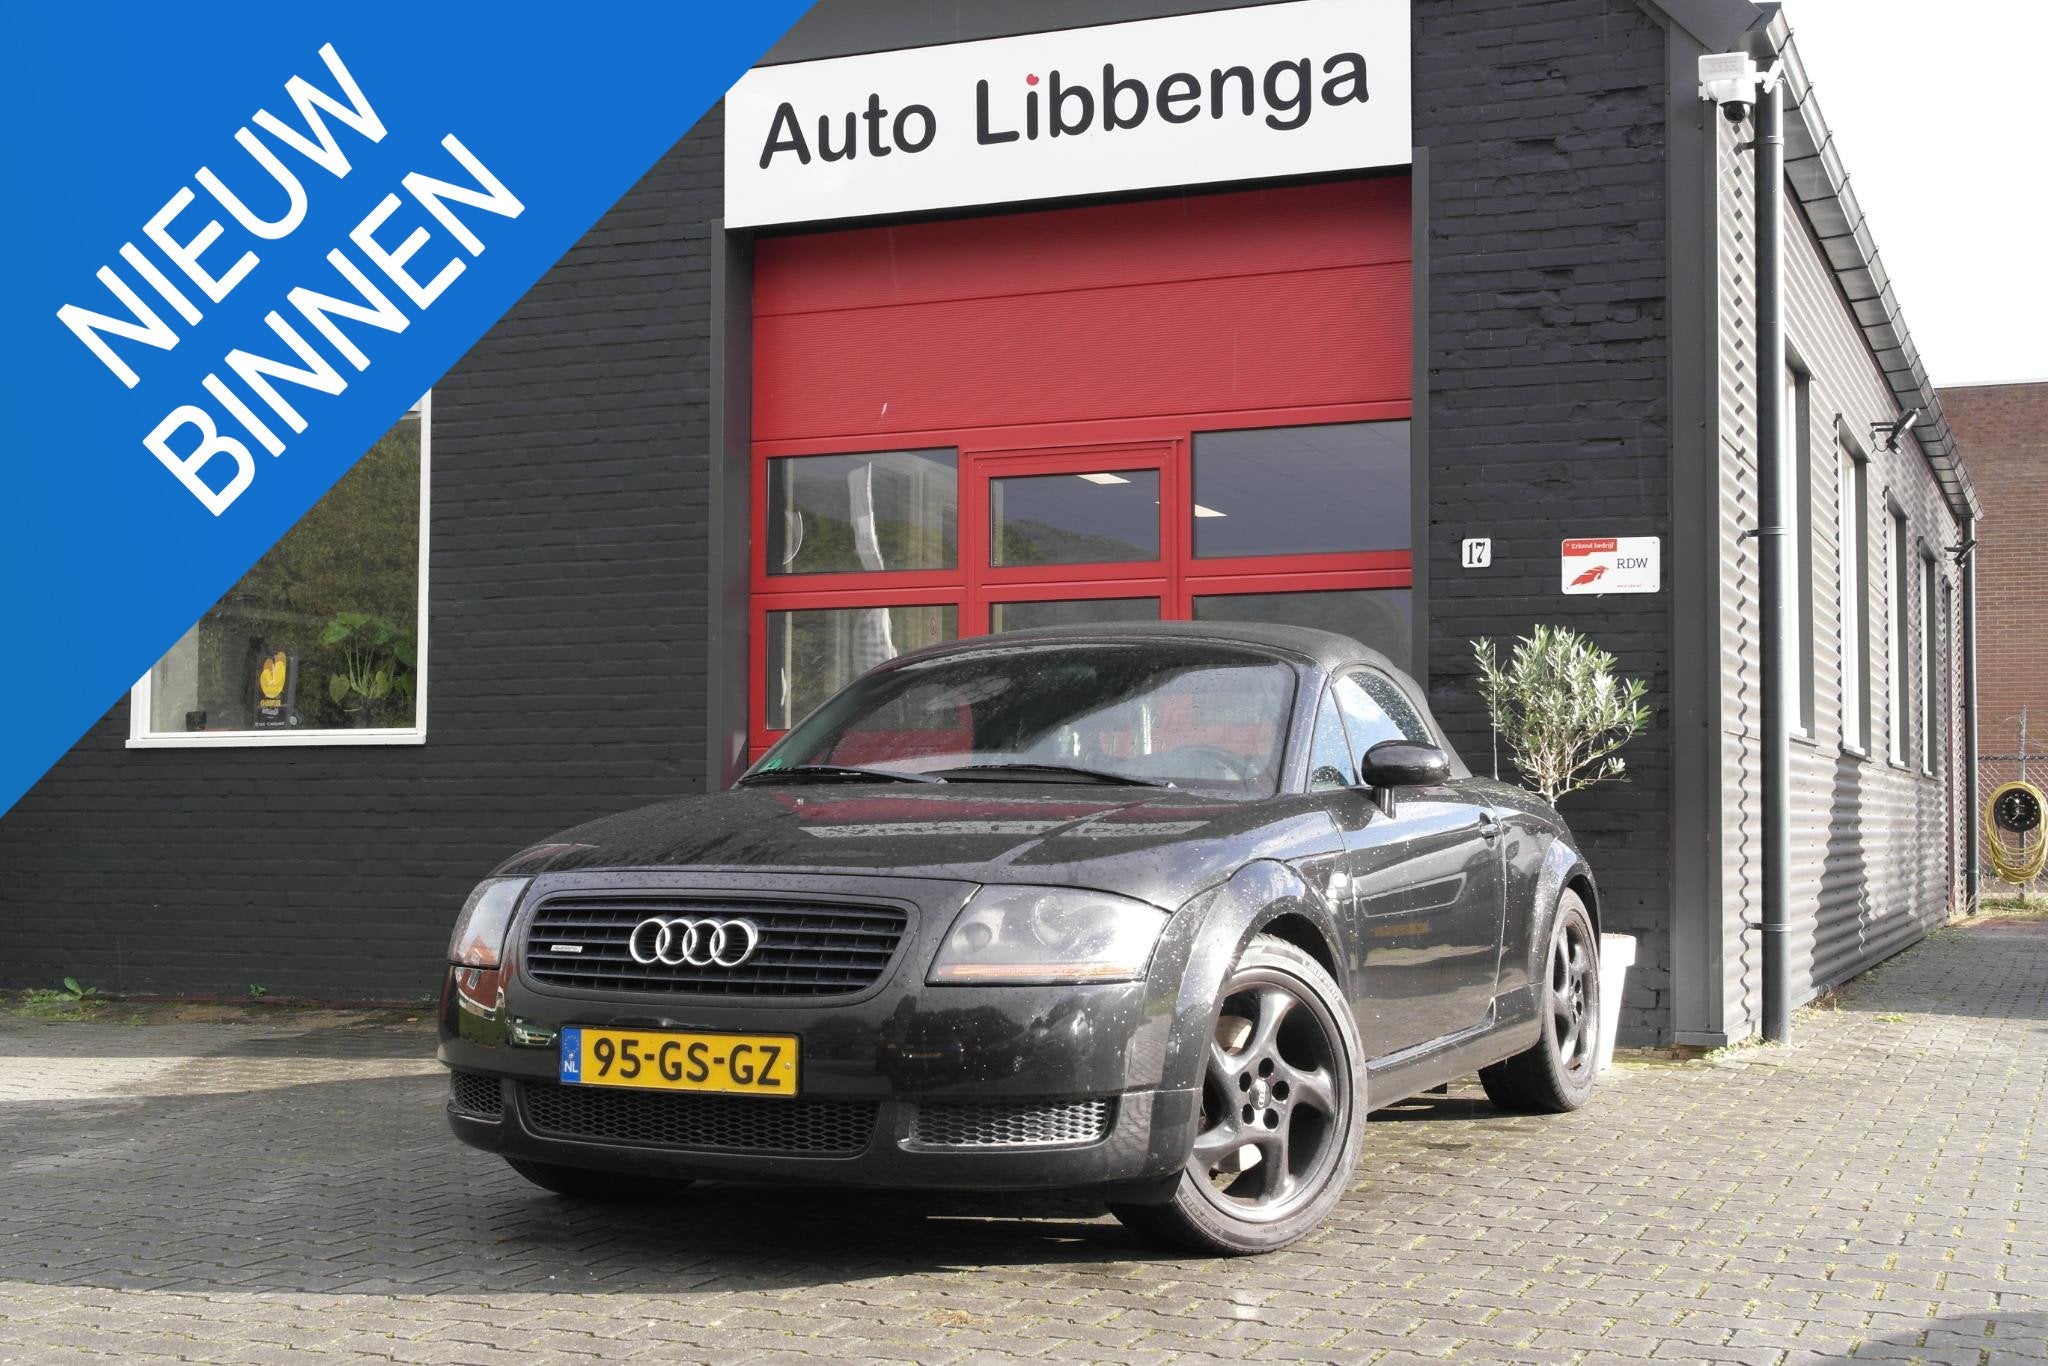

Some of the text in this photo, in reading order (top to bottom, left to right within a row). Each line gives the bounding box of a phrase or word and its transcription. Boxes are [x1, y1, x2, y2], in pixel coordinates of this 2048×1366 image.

[759, 52, 1370, 170] Auto Libbenga
[1467, 541, 1486, 565] 17
[1616, 557, 1648, 569] RDW
[564, 1060, 579, 1073] NL
[593, 1037, 782, 1087] 95-GS-GZ
